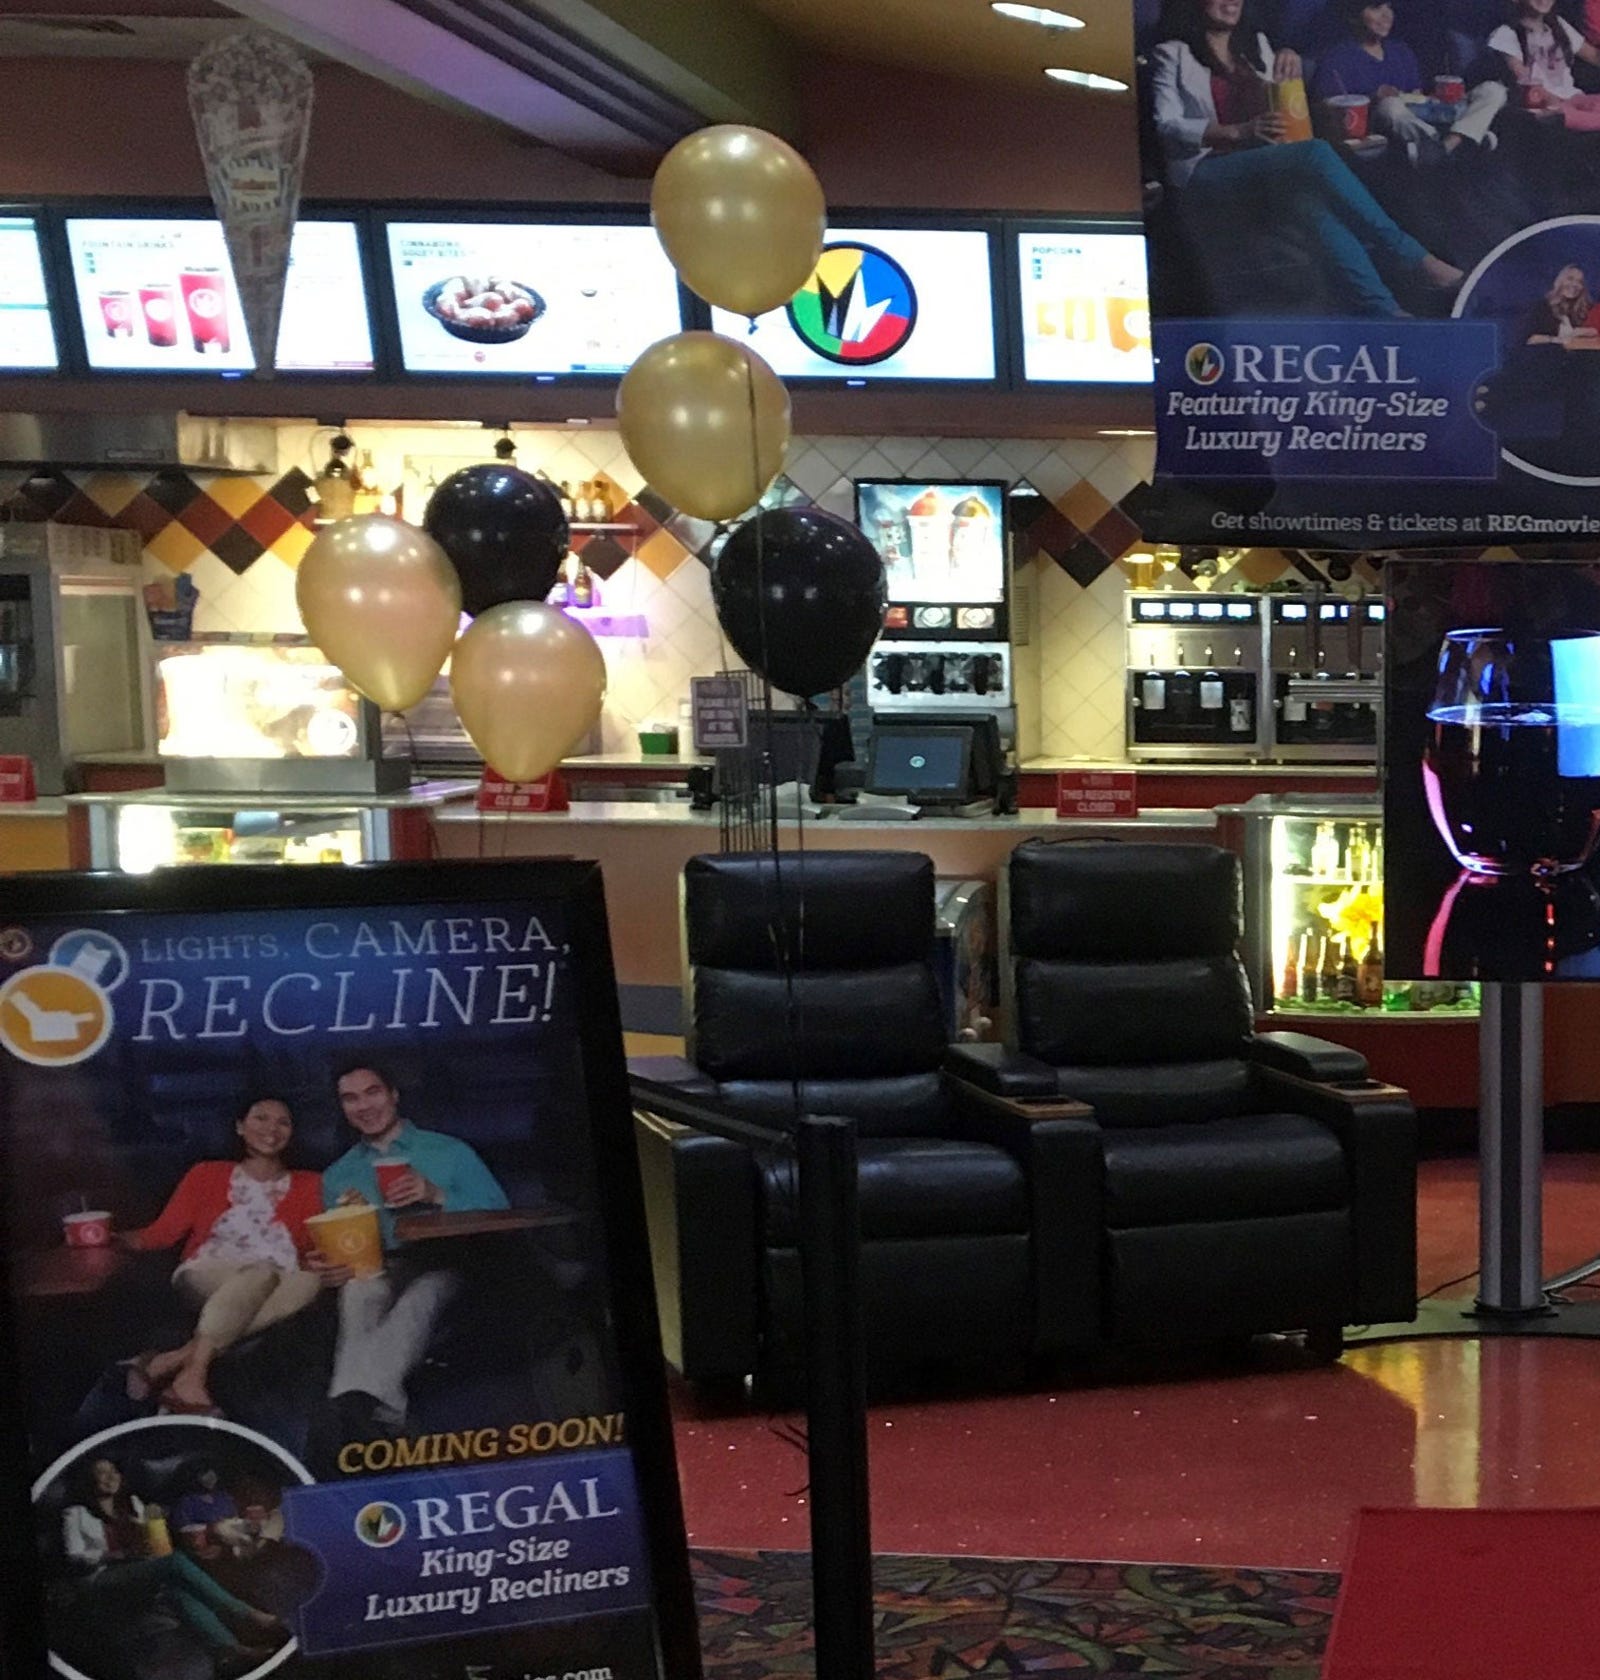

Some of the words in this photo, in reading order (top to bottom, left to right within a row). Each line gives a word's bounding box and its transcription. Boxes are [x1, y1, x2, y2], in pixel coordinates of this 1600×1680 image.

[1231, 343, 1418, 385] REGAL
[1166, 389, 1300, 423] Featuring
[1304, 390, 1449, 424] King-Size
[1185, 425, 1283, 458] Luxury
[1287, 425, 1429, 452] Recliners
[1211, 511, 1245, 530] Get
[1249, 511, 1363, 532] showtimes
[1366, 513, 1385, 532] &
[1388, 513, 1458, 533] tickets
[1462, 515, 1482, 532] at
[304, 915, 572, 959] CAMERA,
[132, 961, 555, 1041] RECLINE!
[338, 1428, 498, 1472] COMING
[507, 1412, 624, 1454] SOON!
[412, 1477, 619, 1540] REGAL
[420, 1537, 570, 1577] King-Size
[364, 1586, 482, 1621] Luxury
[488, 1565, 630, 1604] Recliners
